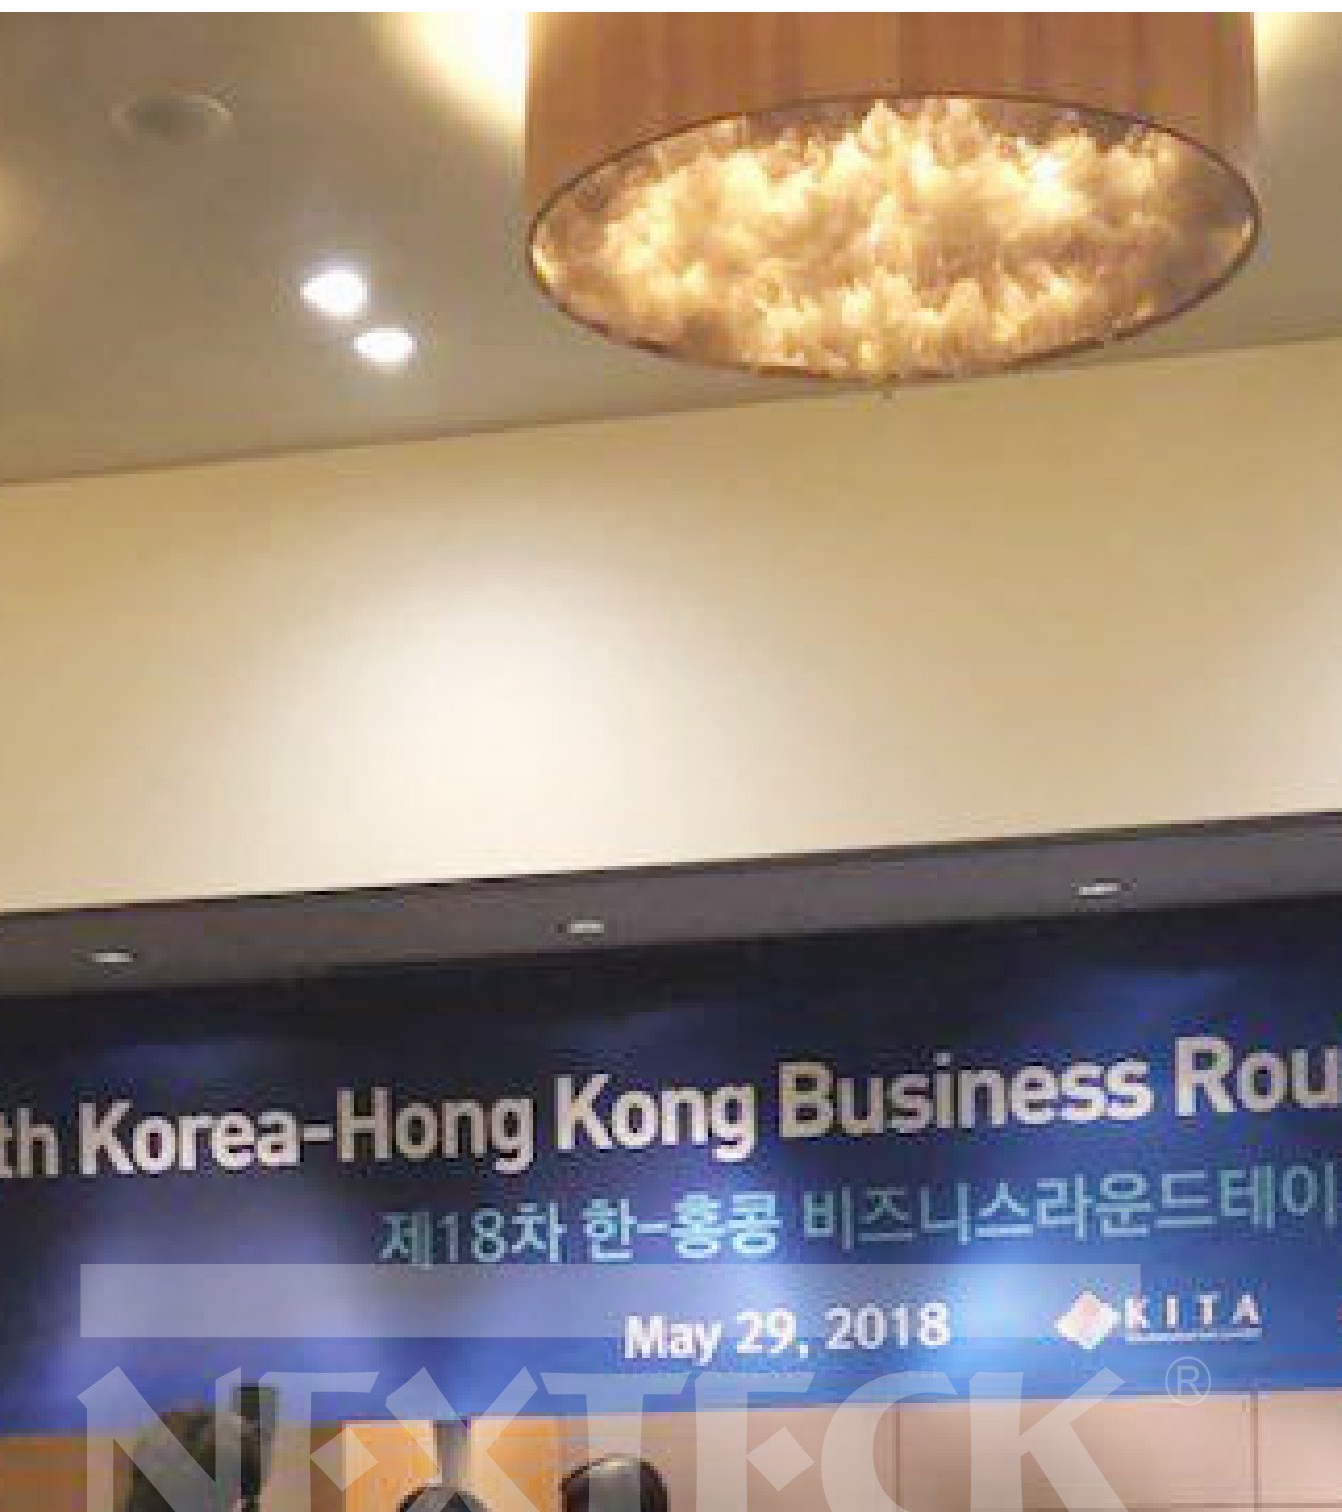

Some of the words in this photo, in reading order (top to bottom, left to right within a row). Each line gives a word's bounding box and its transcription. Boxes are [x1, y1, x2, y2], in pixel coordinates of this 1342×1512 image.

[80, 1086, 533, 1174] Korea-Hong
[553, 1073, 757, 1161] Kong
[778, 1052, 1155, 1139] Business
[380, 1202, 568, 1269] 제18차
[581, 1190, 781, 1263] 한-홍콩
[624, 1314, 722, 1366] May
[736, 1307, 809, 1358] 29,
[824, 1302, 951, 1350] 2018
[1123, 1294, 1263, 1330] KITA
